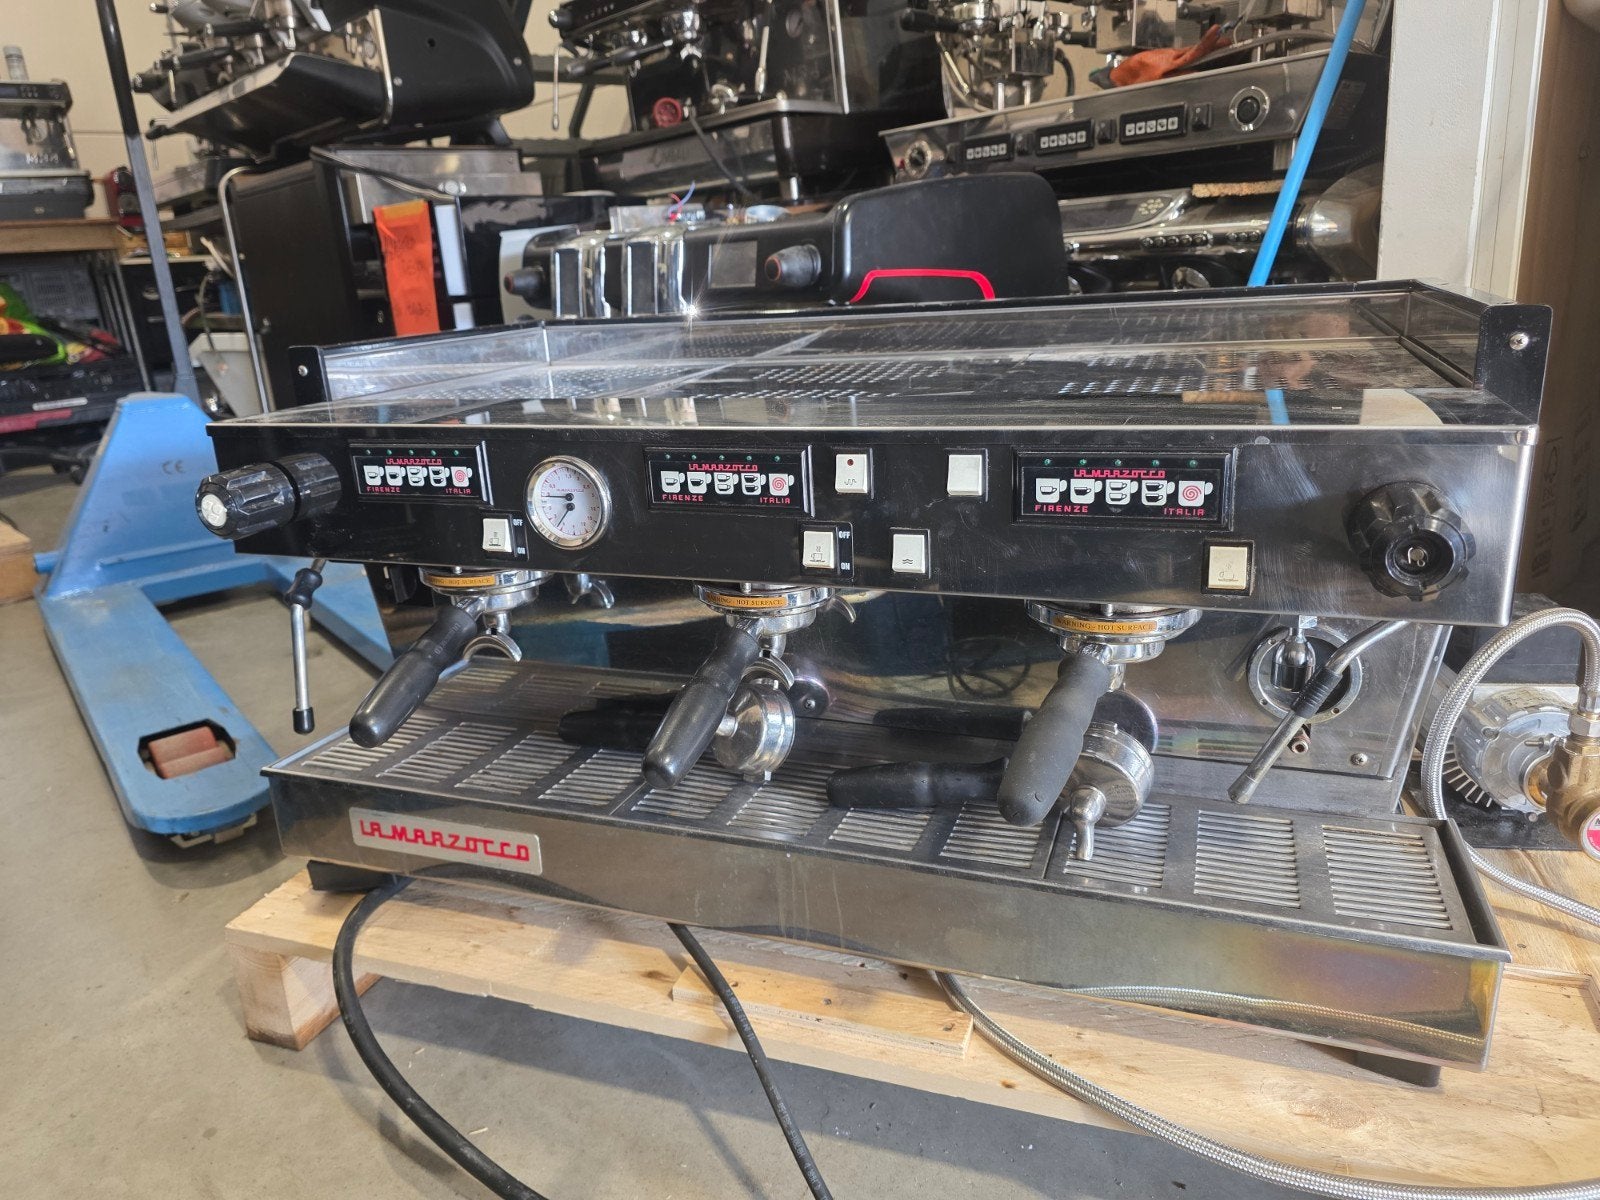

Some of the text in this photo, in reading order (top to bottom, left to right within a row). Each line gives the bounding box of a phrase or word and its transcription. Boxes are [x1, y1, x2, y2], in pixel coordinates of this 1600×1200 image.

[701, 463, 759, 472] MARZOCCO
[1073, 469, 1166, 479] LA MARZOCCO
[662, 494, 704, 502] FIRENZE
[1034, 505, 1206, 516] FIRENZE ITALIA
[513, 518, 523, 526] OFF
[838, 530, 850, 539] OFF
[840, 562, 850, 570] ON
[359, 819, 530, 862] LA MARZOCCO
